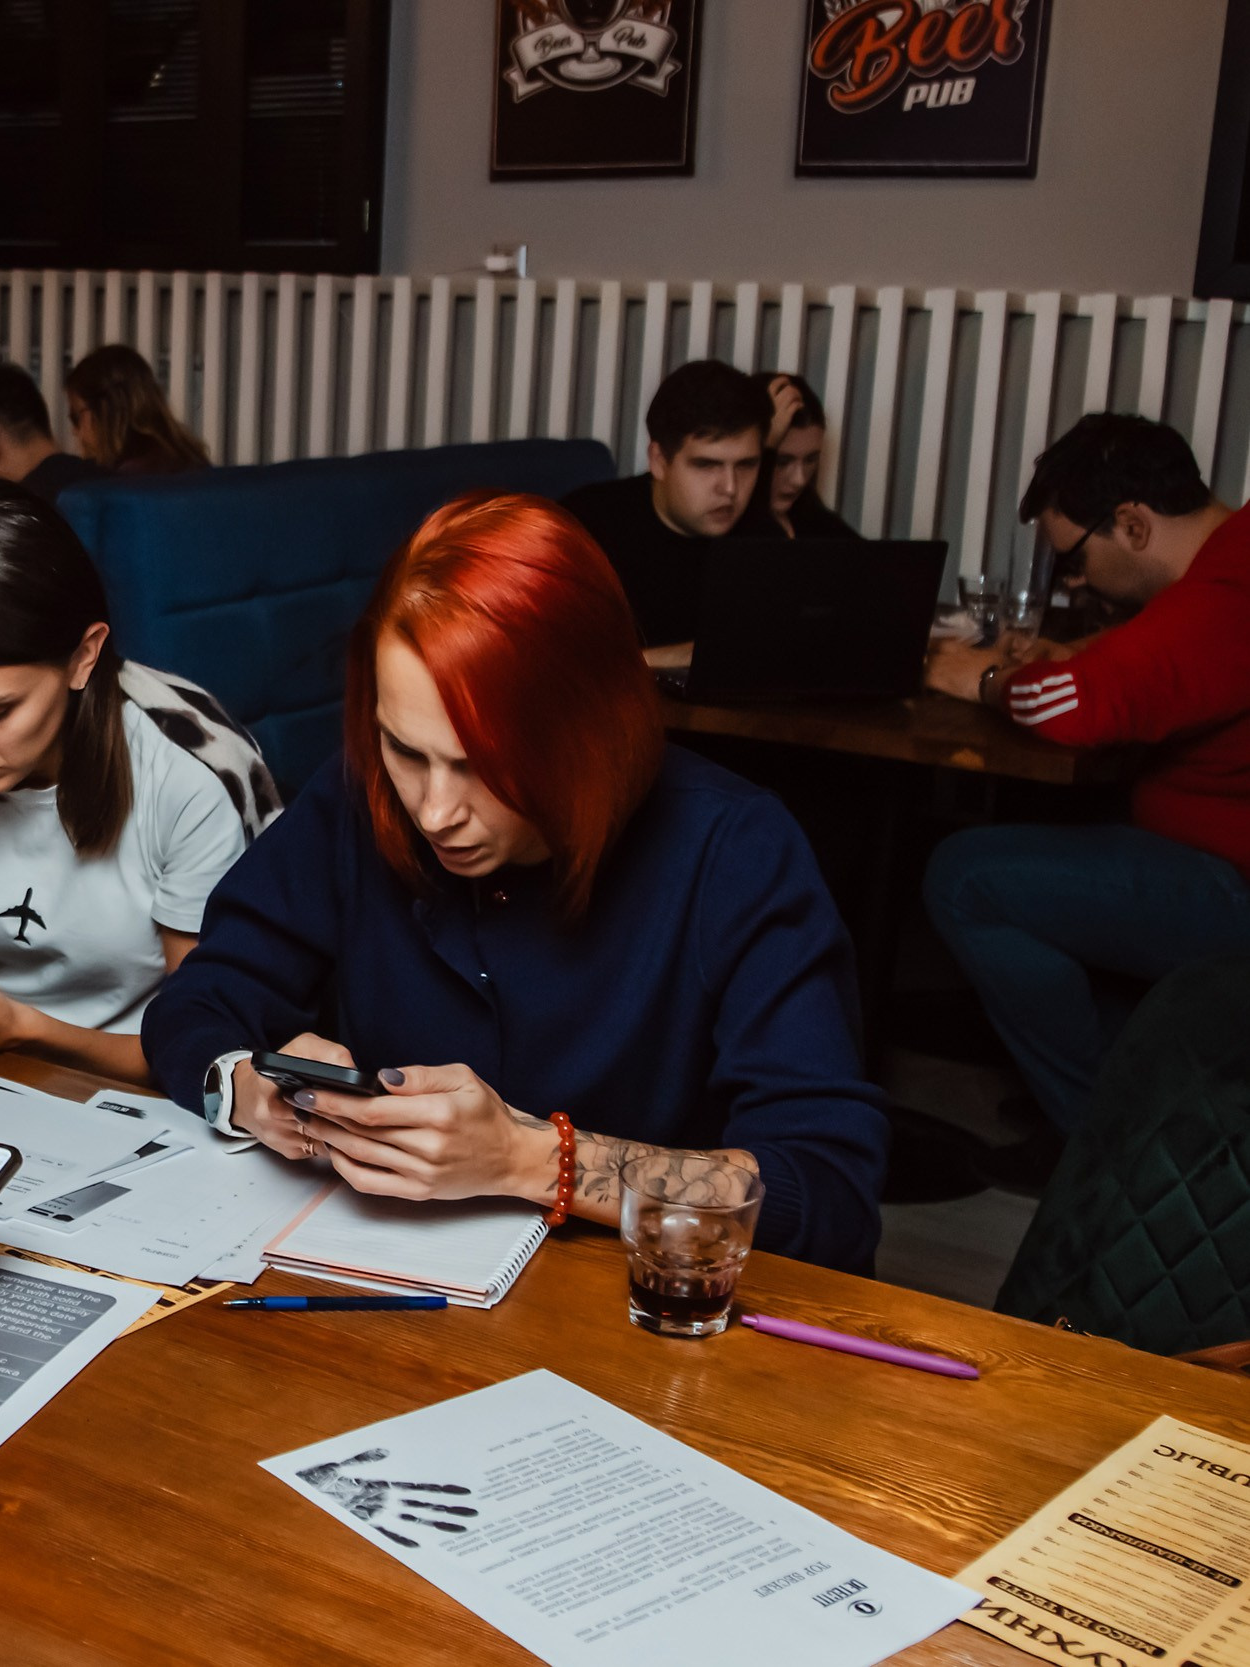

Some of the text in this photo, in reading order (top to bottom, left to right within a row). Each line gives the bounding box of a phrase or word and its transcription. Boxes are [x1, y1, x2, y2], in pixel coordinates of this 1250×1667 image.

[534, 25, 648, 59] Beer Pub
[811, 0, 1018, 110] Beer
[902, 77, 976, 112] PUB
[0, 1274, 55, 1292] remember
[58, 1288, 82, 1298] well
[83, 1294, 101, 1303] the
[26, 1289, 50, 1299] with
[52, 1295, 82, 1306] solid
[1, 1305, 38, 1320] letters
[10, 1294, 32, 1302] you
[34, 1299, 55, 1308] can
[57, 1302, 91, 1317] easily
[26, 1303, 47, 1314] this
[50, 1309, 76, 1322] date
[8, 1322, 32, 1335] and
[32, 1328, 52, 1340] the
[753, 1561, 832, 1598] TOP SECRET
[812, 1579, 868, 1608] DETECTIT
[995, 1582, 1061, 1616] ТЕСТЕ
[1063, 1611, 1092, 1628] НА
[1095, 1625, 1155, 1655] МЯСО
